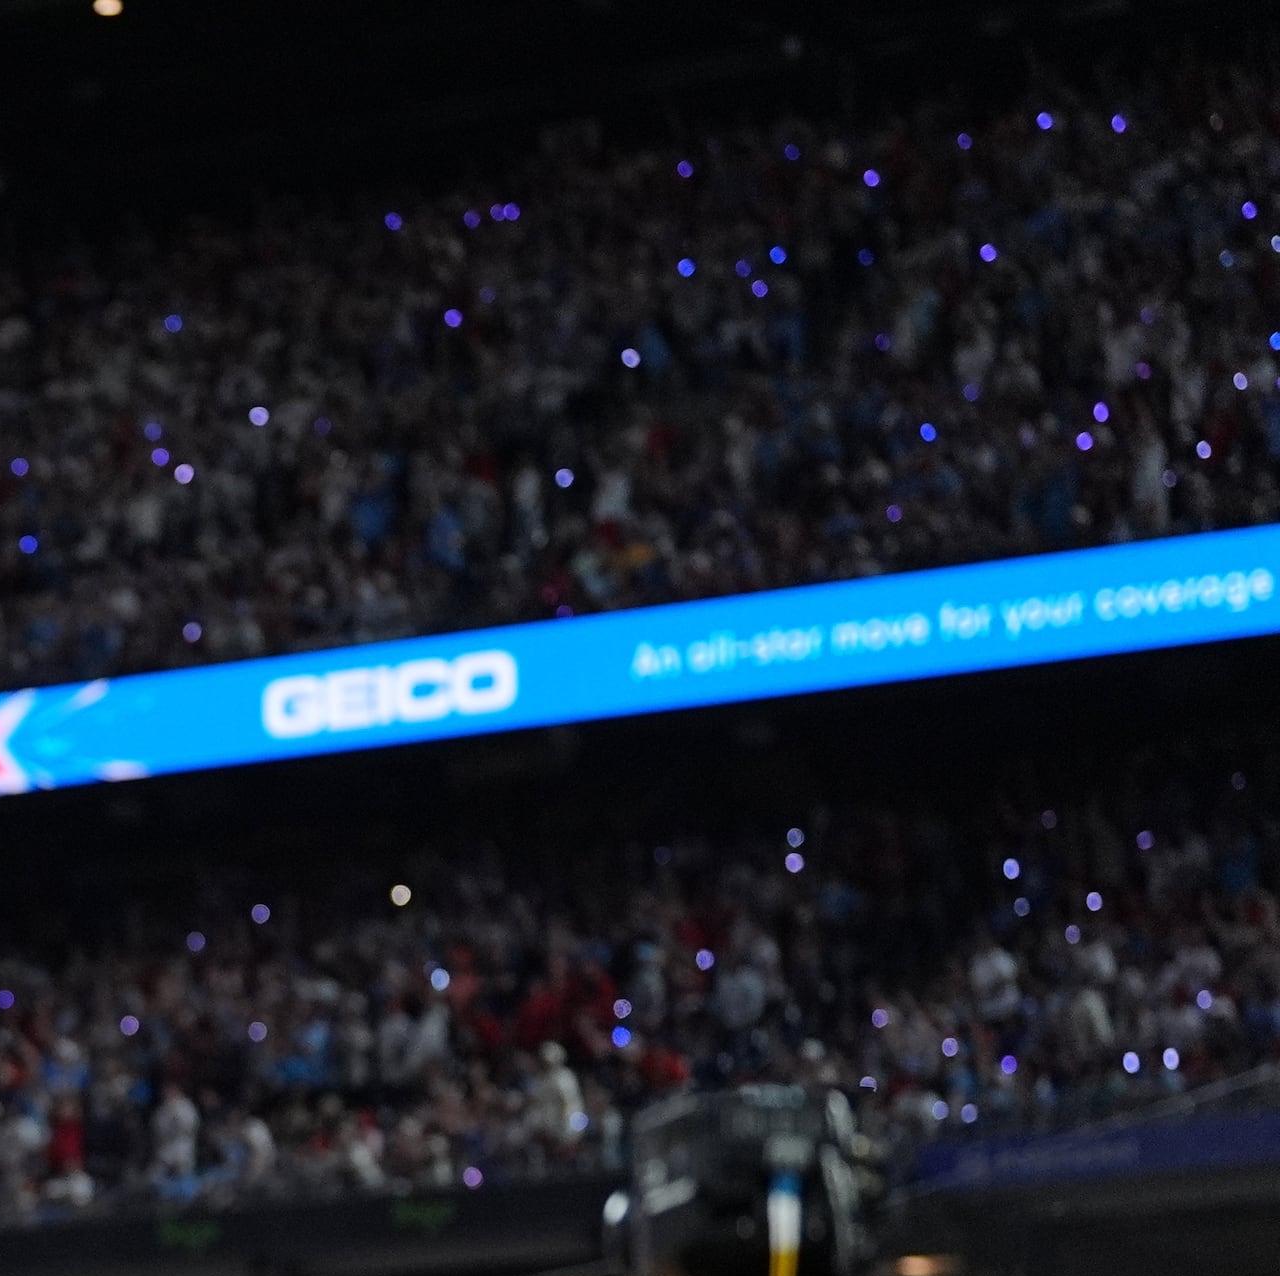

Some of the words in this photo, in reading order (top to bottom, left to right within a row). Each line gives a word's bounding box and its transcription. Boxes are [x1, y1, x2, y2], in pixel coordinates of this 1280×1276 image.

[830, 613, 930, 655] move
[939, 600, 992, 640] for
[1001, 592, 1083, 640] your
[1094, 568, 1274, 622] coverage
[263, 651, 517, 738] GEICO
